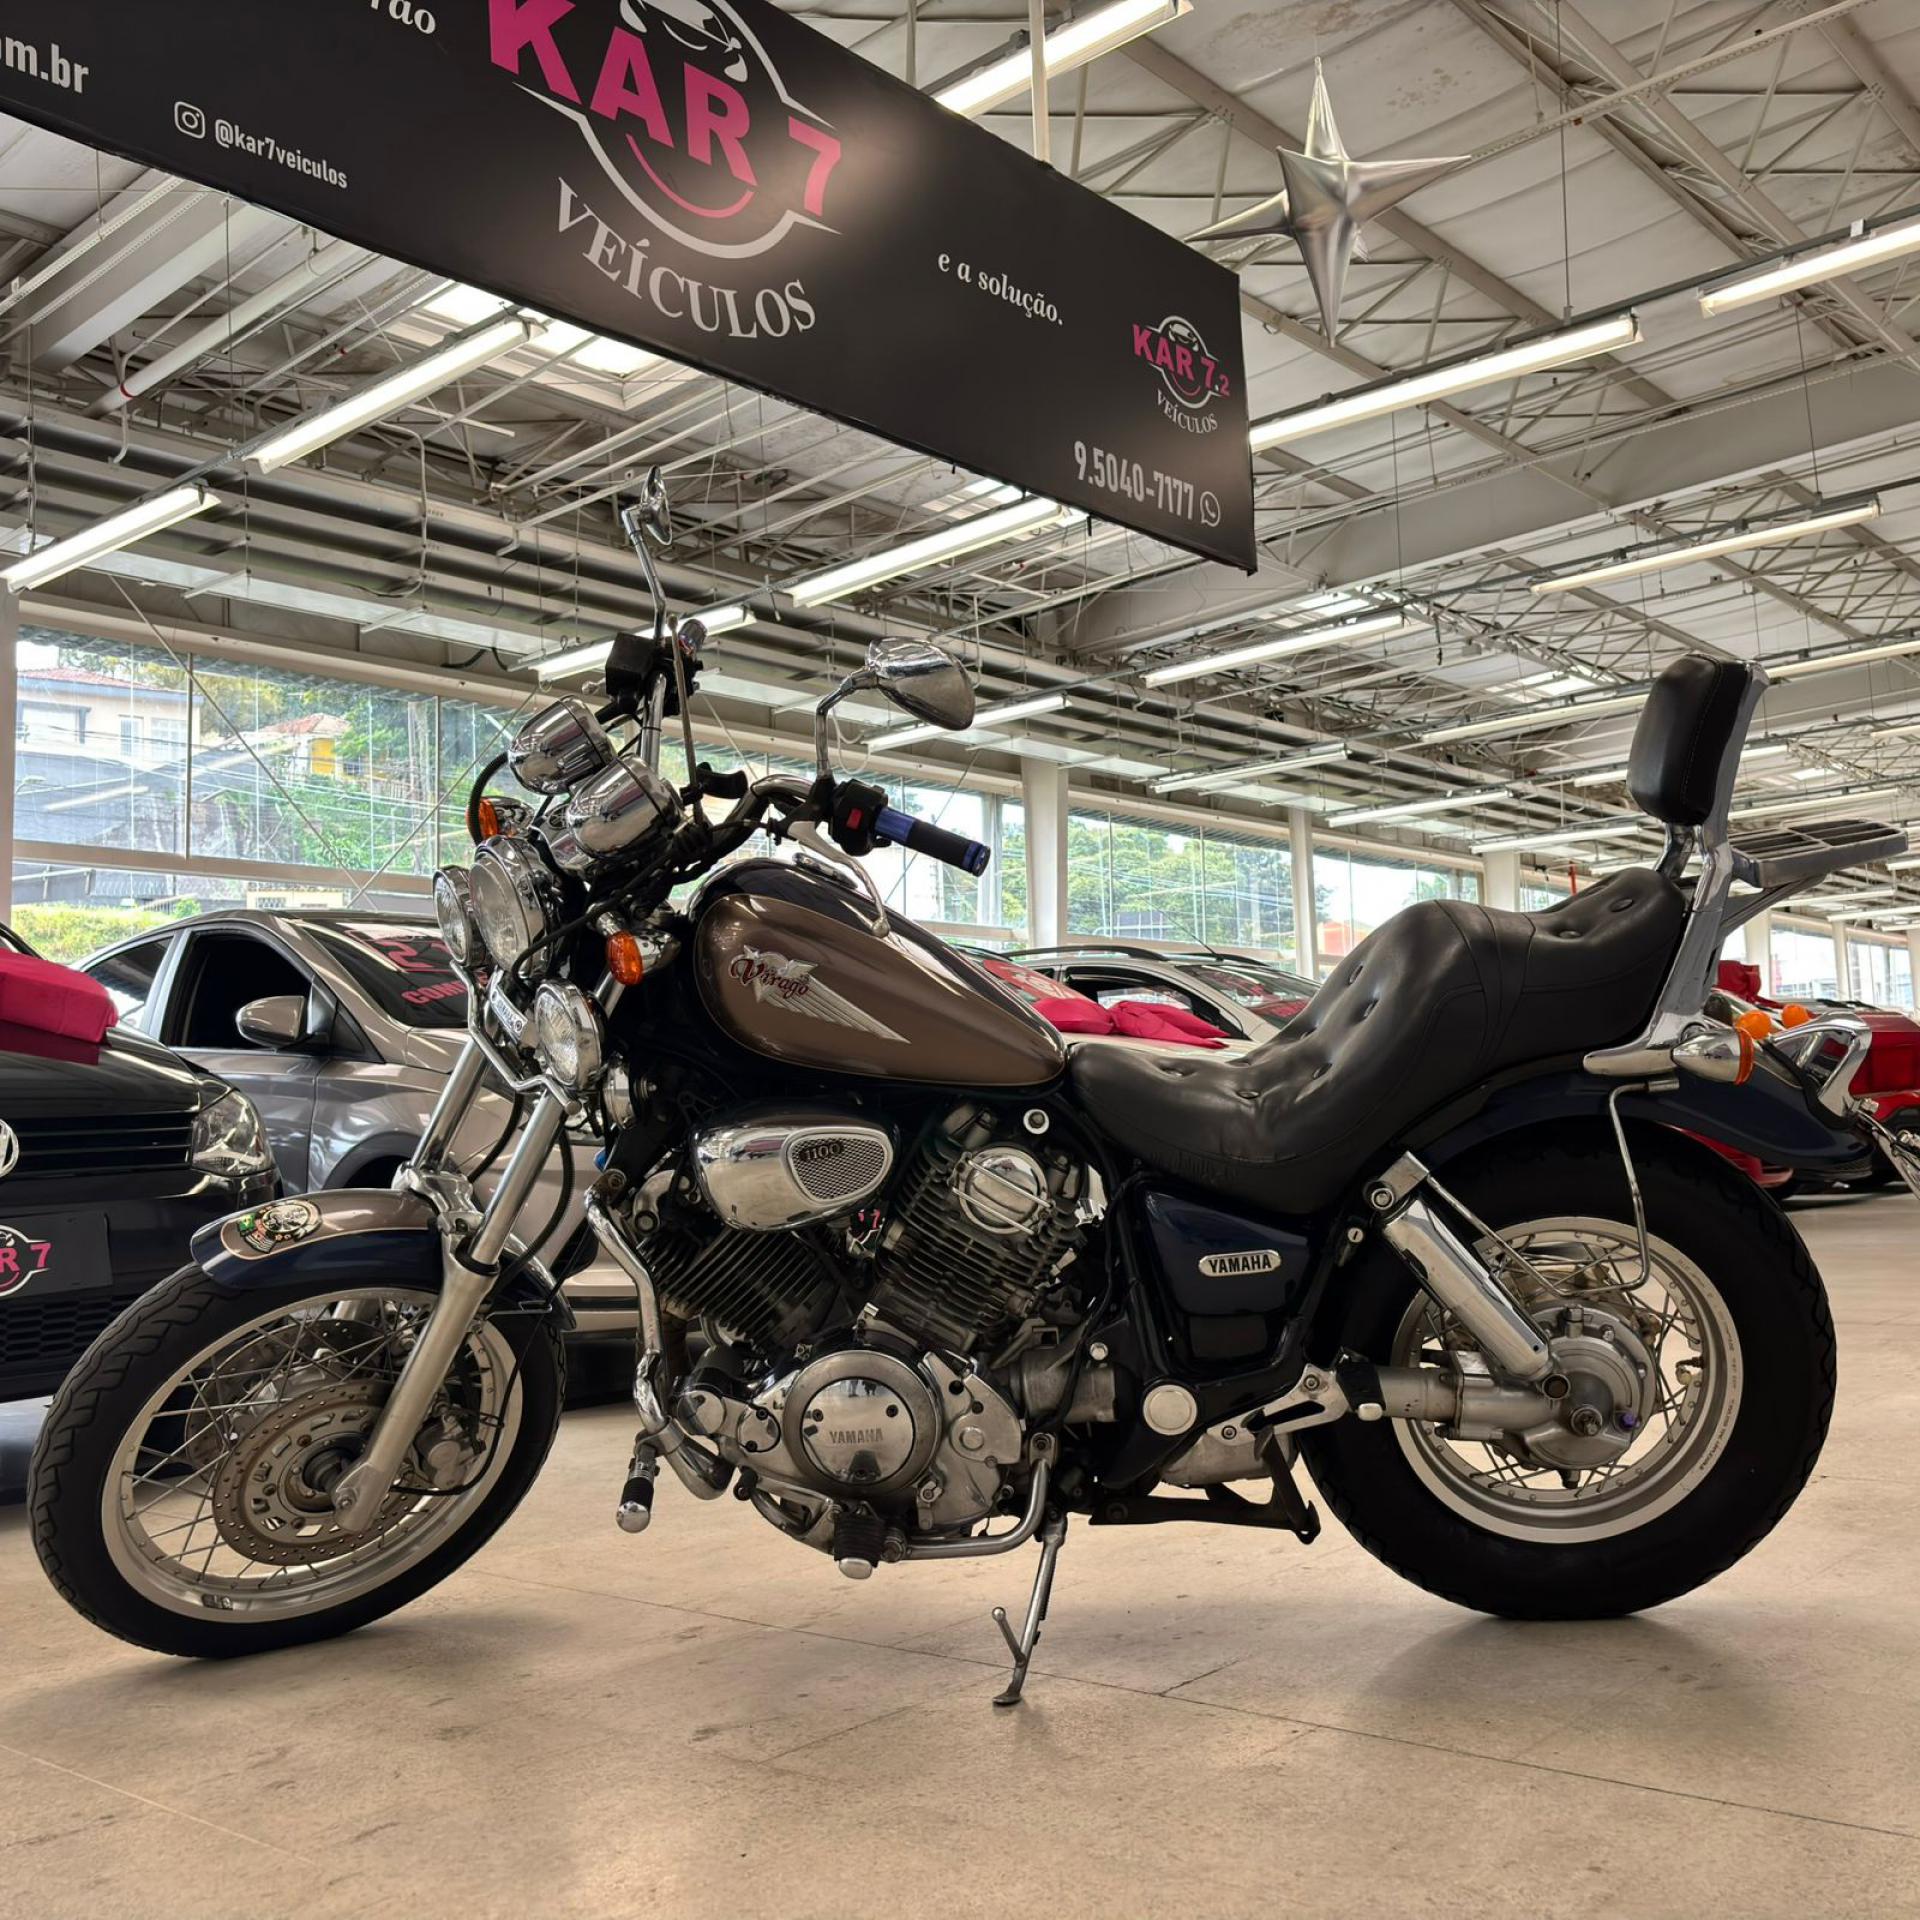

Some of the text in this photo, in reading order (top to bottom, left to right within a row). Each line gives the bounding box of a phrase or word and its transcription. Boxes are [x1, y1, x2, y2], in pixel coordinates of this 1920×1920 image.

[0, 36, 89, 94] m.br
[487, 0, 841, 217] KAR 7
[214, 118, 348, 189] @kar7veiculos
[557, 176, 816, 338] VEÍCULOS
[938, 252, 1064, 326] e a solução.
[1132, 323, 1194, 381] KAR
[1157, 388, 1218, 434] VEÍCULOS
[1073, 440, 1195, 521] 9.5040-7177
[730, 957, 811, 1000] Virago
[805, 1142, 841, 1161] 1100
[30, 1242, 51, 1268] 7
[1208, 1254, 1272, 1274] YAMAHA
[829, 1427, 884, 1444] YAMAHA
